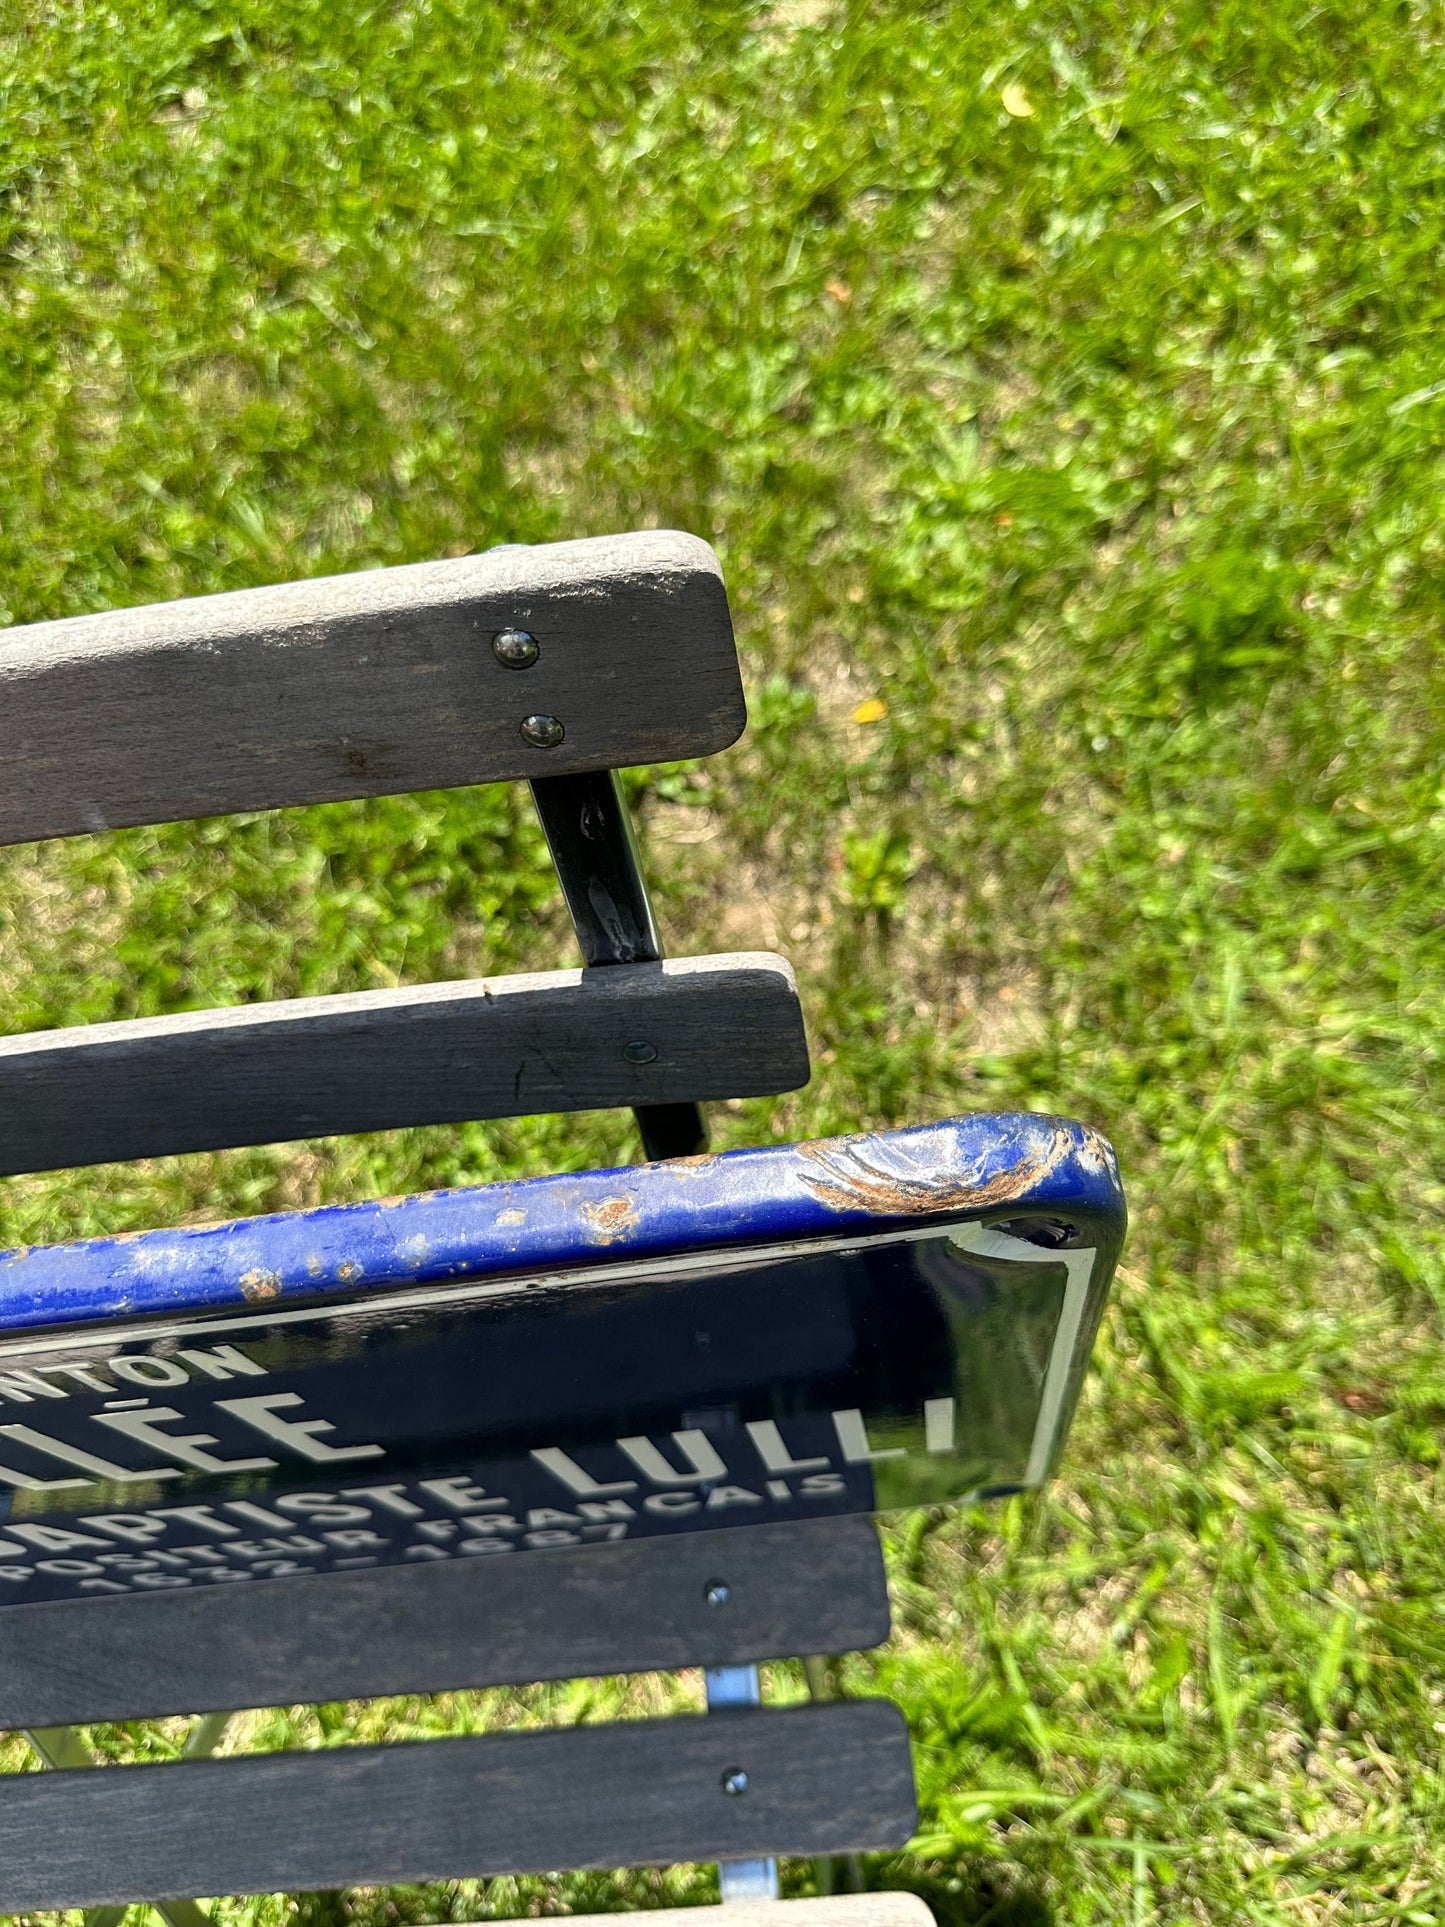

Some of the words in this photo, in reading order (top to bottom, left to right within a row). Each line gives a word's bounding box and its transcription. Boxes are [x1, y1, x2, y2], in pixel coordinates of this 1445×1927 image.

[0, 1344, 269, 1404] NTON
[0, 1476, 509, 1558] APTISTE
[530, 1397, 956, 1497] LULLI
